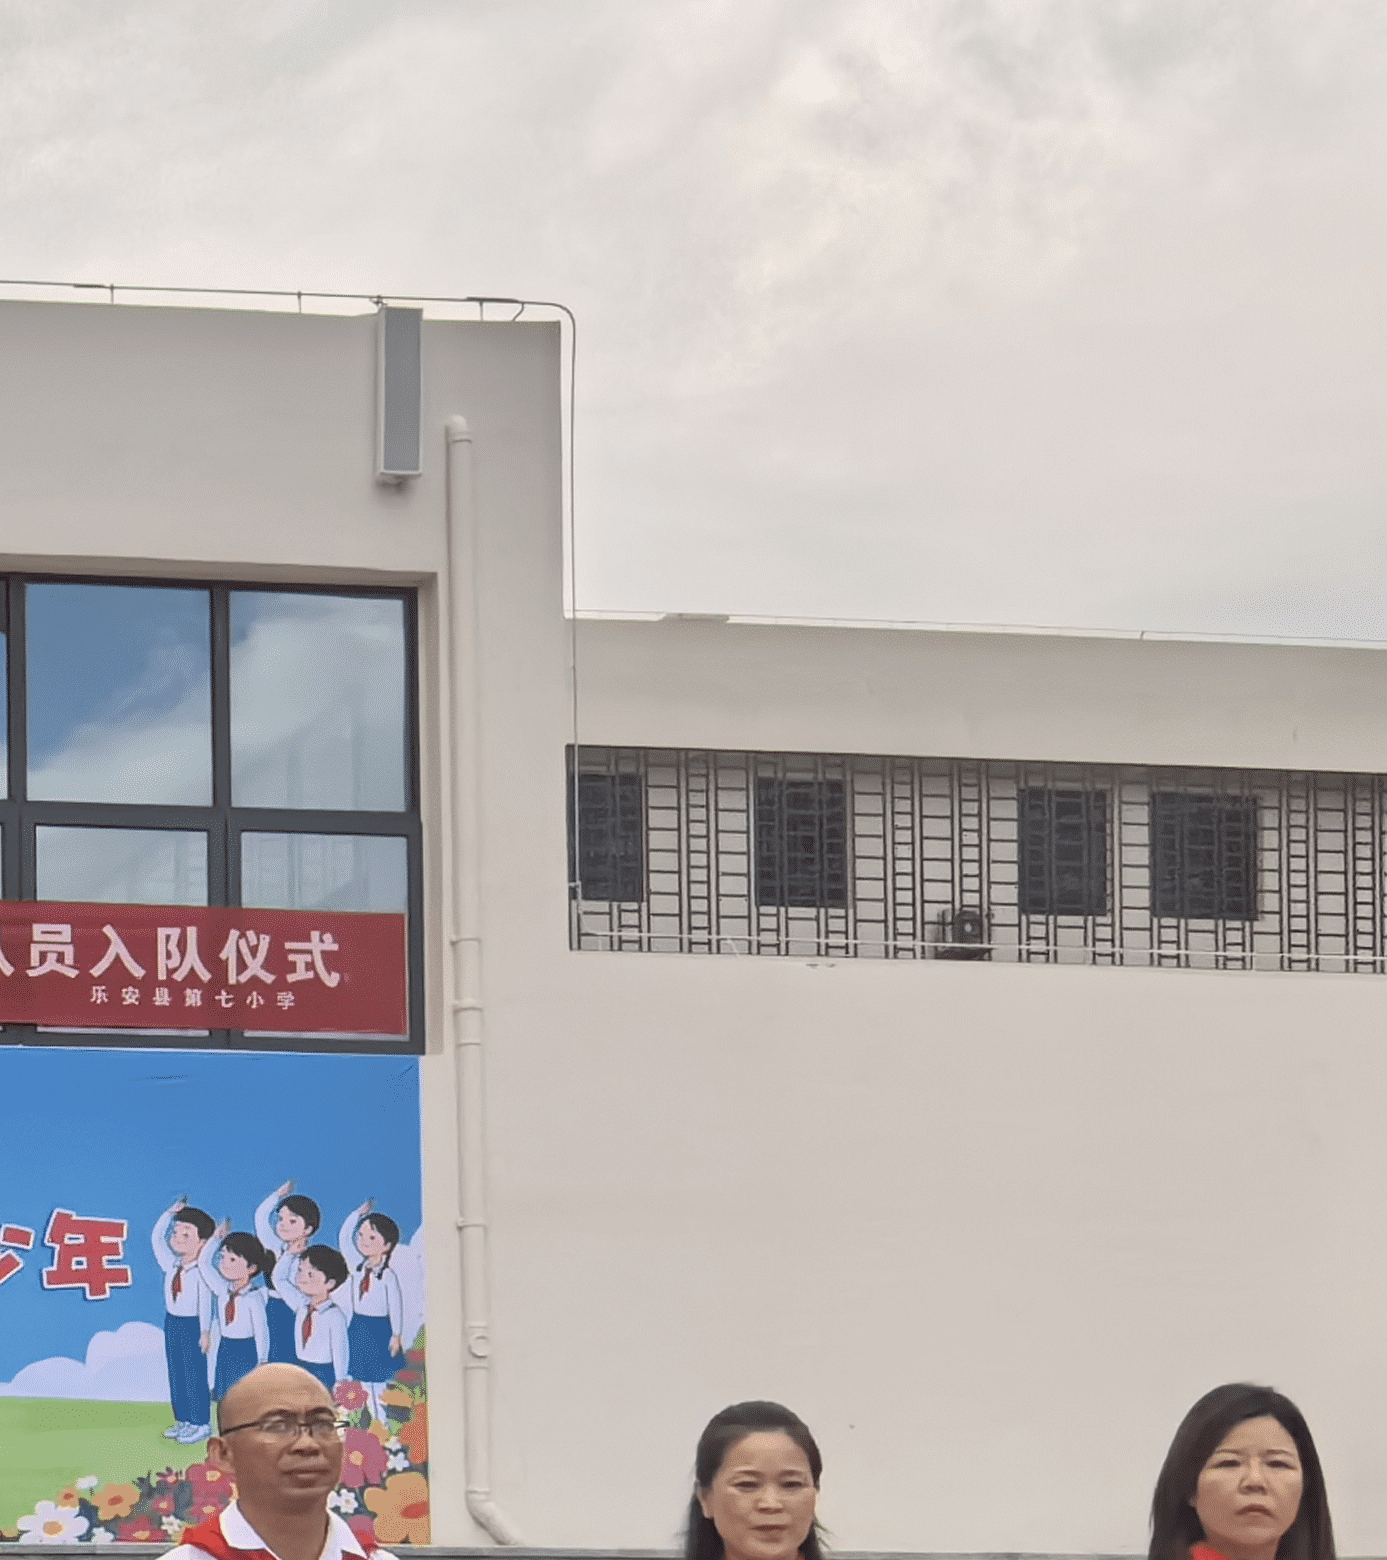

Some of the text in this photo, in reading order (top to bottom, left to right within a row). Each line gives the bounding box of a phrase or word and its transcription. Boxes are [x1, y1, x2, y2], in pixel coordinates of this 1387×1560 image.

[89, 985, 296, 1011] 乐安县第七小学
